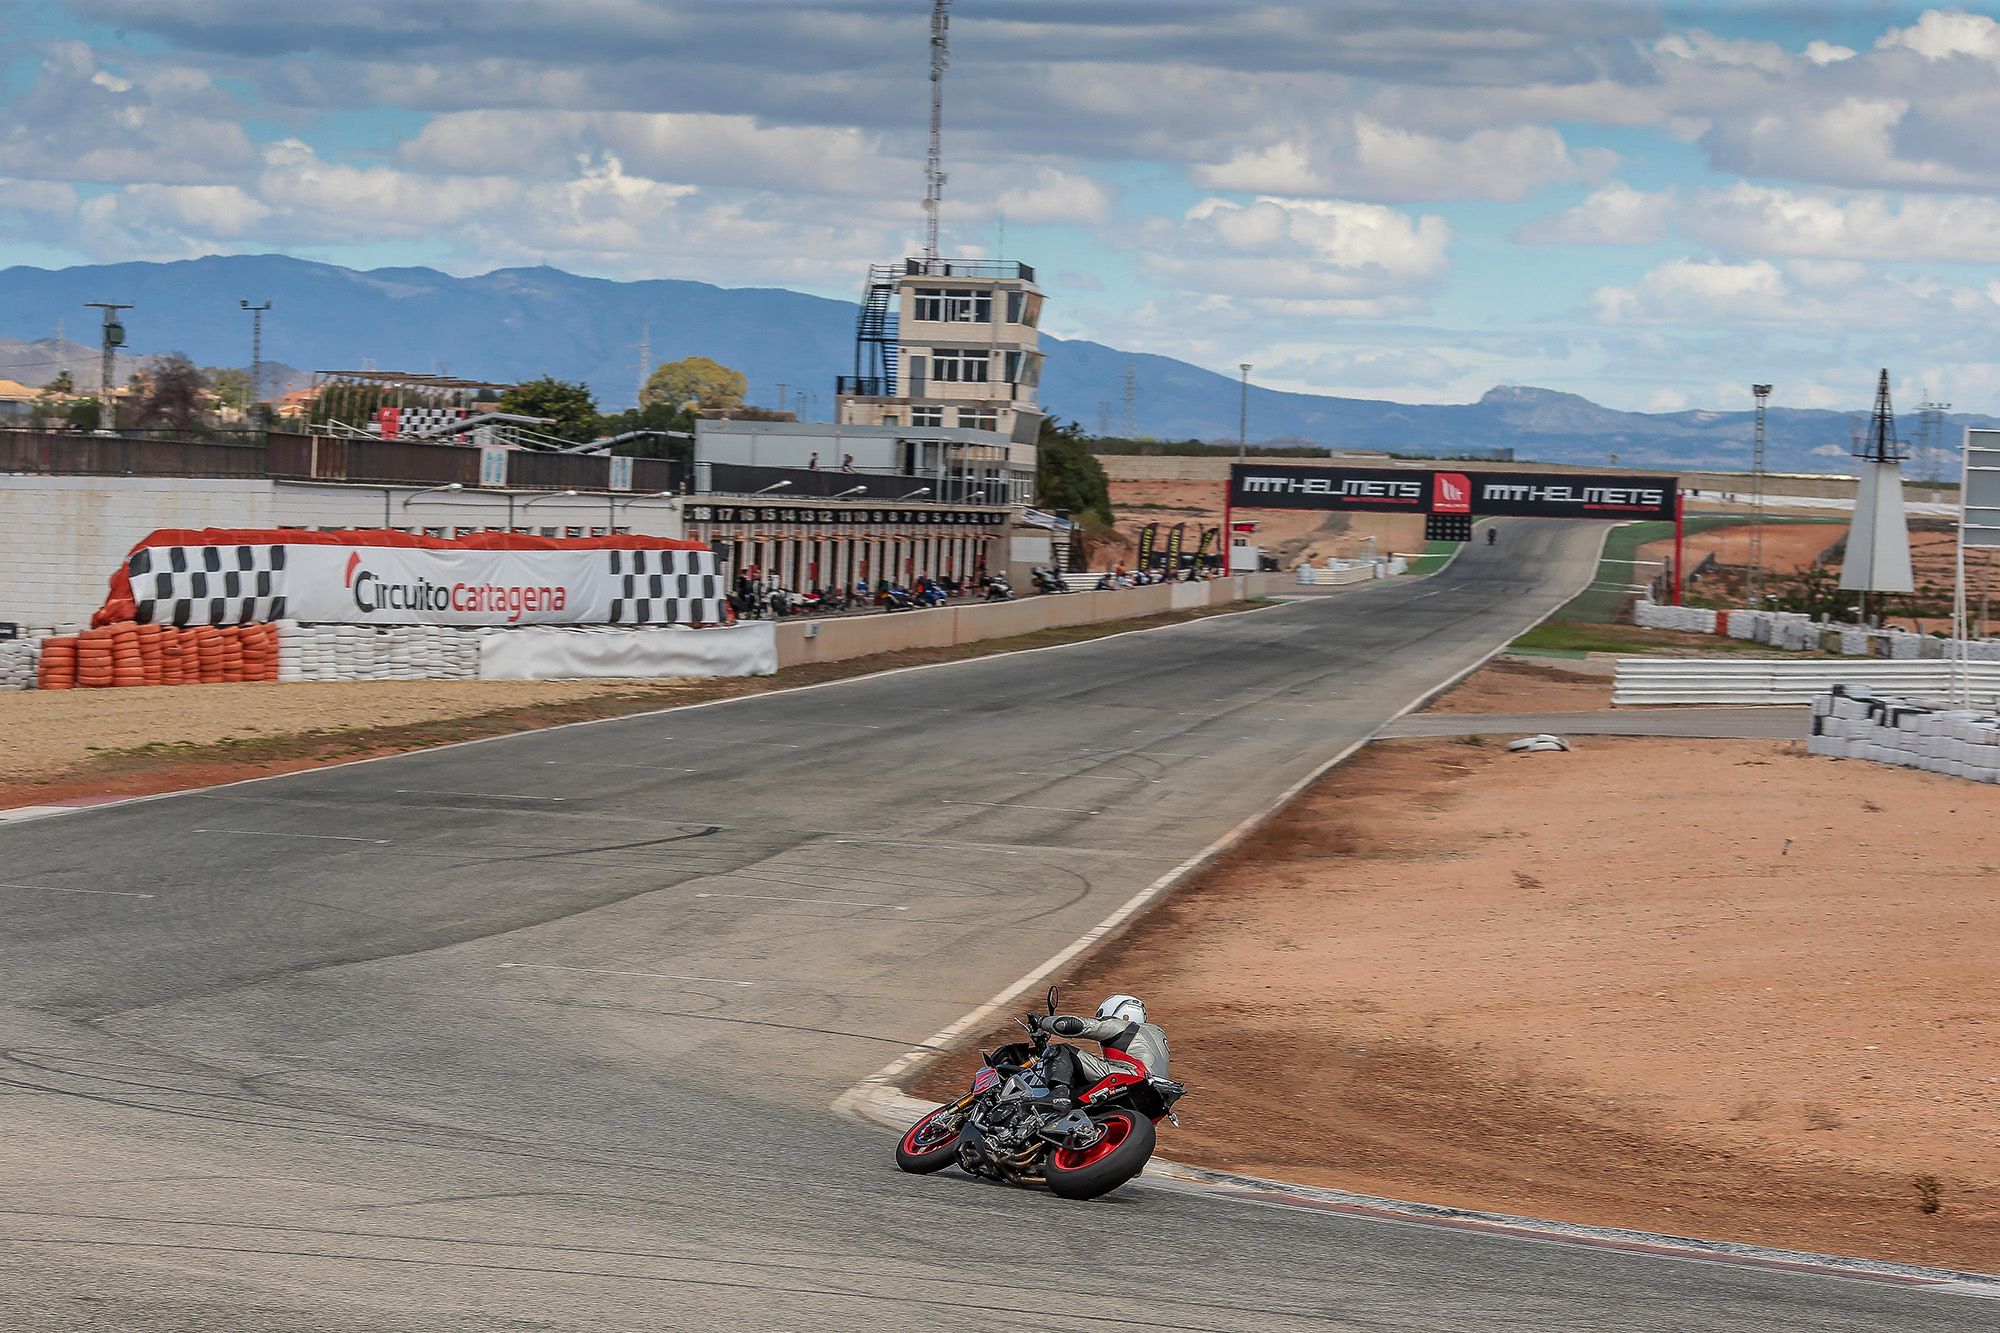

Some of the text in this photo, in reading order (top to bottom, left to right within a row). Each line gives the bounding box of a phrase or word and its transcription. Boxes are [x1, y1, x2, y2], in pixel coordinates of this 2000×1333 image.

[693, 507, 711, 520] 18
[717, 508, 734, 521] 17
[738, 508, 756, 521] 16
[760, 508, 776, 522] 15
[780, 509, 796, 522] 14
[800, 510, 815, 522] 13
[817, 510, 833, 522] 12
[839, 511, 852, 522] 11
[853, 511, 869, 522] 10
[872, 511, 883, 522] 9
[888, 512, 898, 522] 8
[904, 512, 914, 523] 7
[917, 512, 927, 523] 6
[932, 512, 942, 523] 5
[944, 512, 954, 523] 4
[957, 513, 967, 523] 3
[969, 513, 979, 523] 2
